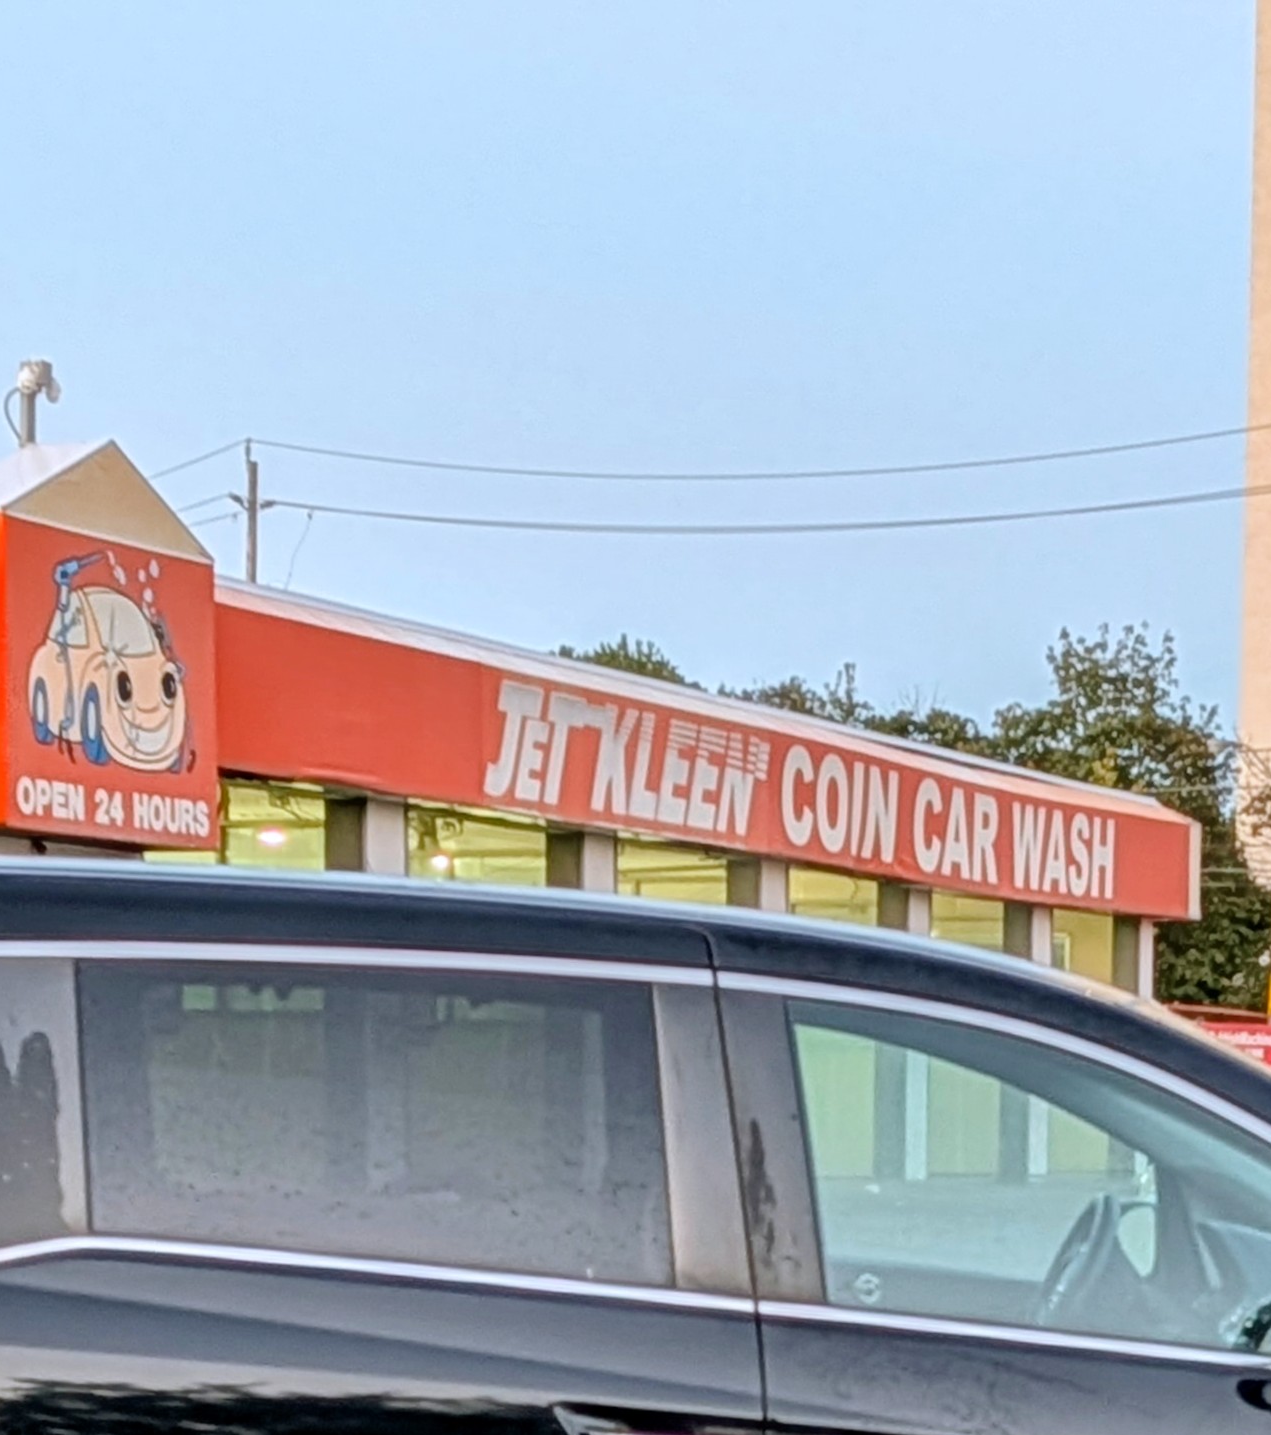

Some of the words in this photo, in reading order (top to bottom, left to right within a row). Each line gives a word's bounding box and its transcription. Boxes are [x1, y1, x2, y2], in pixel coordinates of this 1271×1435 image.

[16, 776, 85, 822] OPEN
[95, 788, 124, 827] 24
[132, 792, 210, 838] HOURS
[483, 679, 588, 805] JET
[585, 702, 771, 836] KLEEN
[781, 743, 899, 864] COIN
[913, 777, 999, 885] CAR
[1011, 804, 1116, 900] WASH
